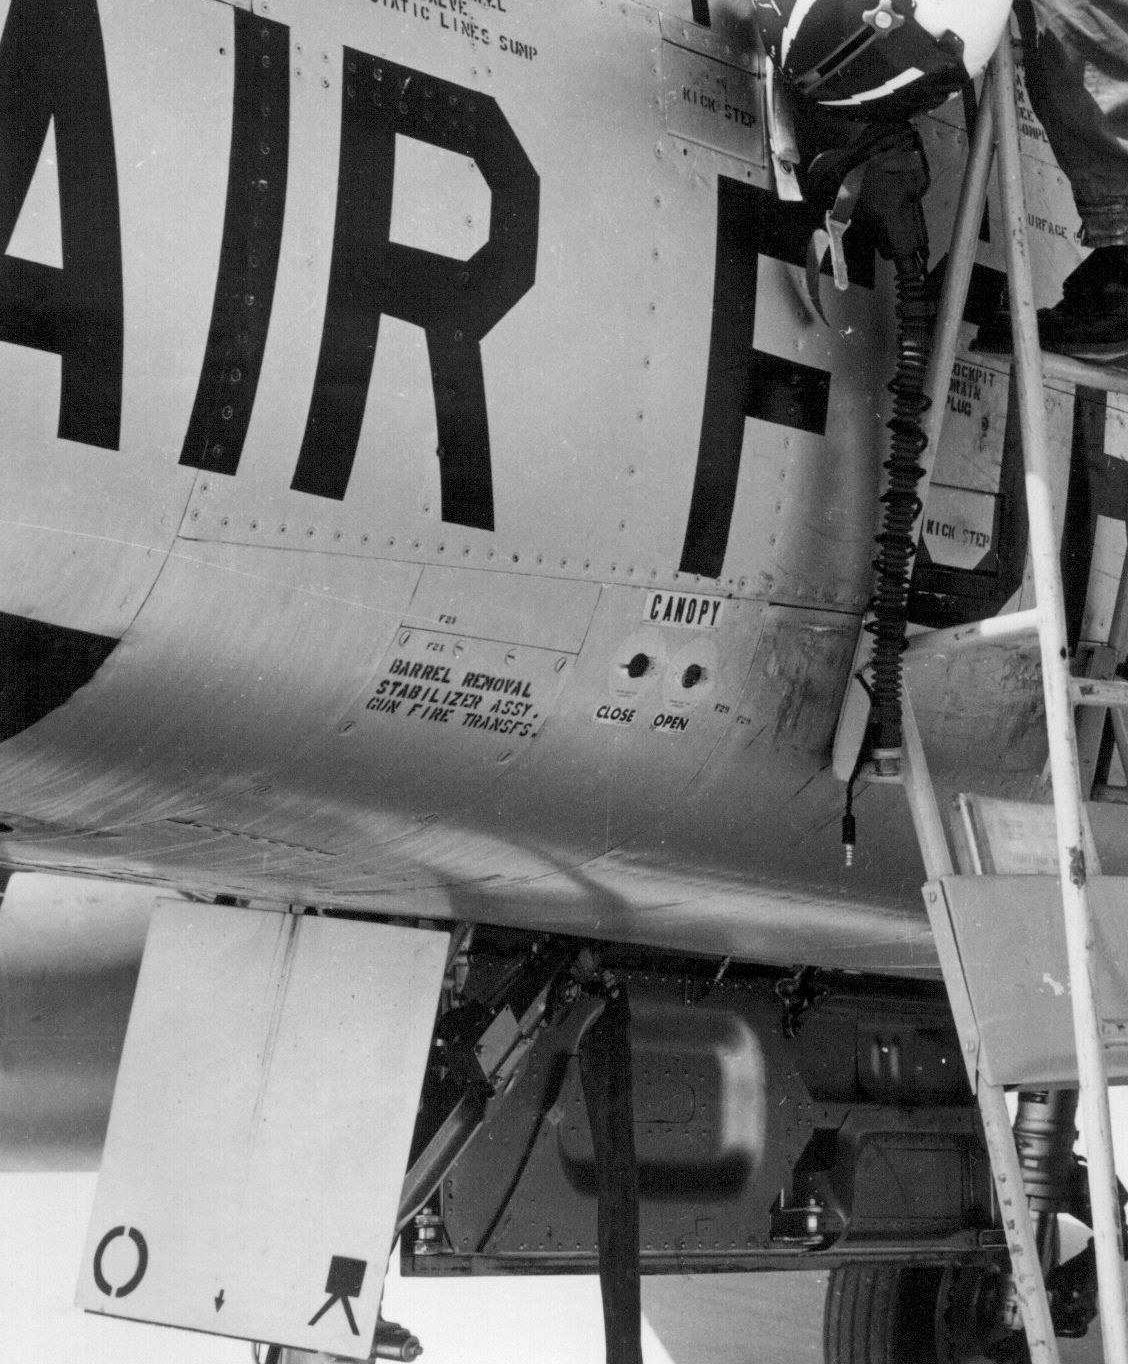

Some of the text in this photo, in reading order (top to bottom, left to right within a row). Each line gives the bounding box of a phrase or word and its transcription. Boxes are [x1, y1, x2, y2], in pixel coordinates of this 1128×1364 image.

[440, 11, 491, 46] LINES
[499, 34, 539, 62] SUMP
[681, 86, 758, 129] KICK STEP
[926, 519, 992, 560] KICK STEP
[649, 593, 721, 627] CANOPY
[375, 678, 540, 720] STABILIZER ASSY.
[388, 657, 533, 699] BARREL REMOVAL
[365, 696, 539, 738] GUN FIRE TRANSFS.
[596, 704, 690, 732] CLOSE OPEN
